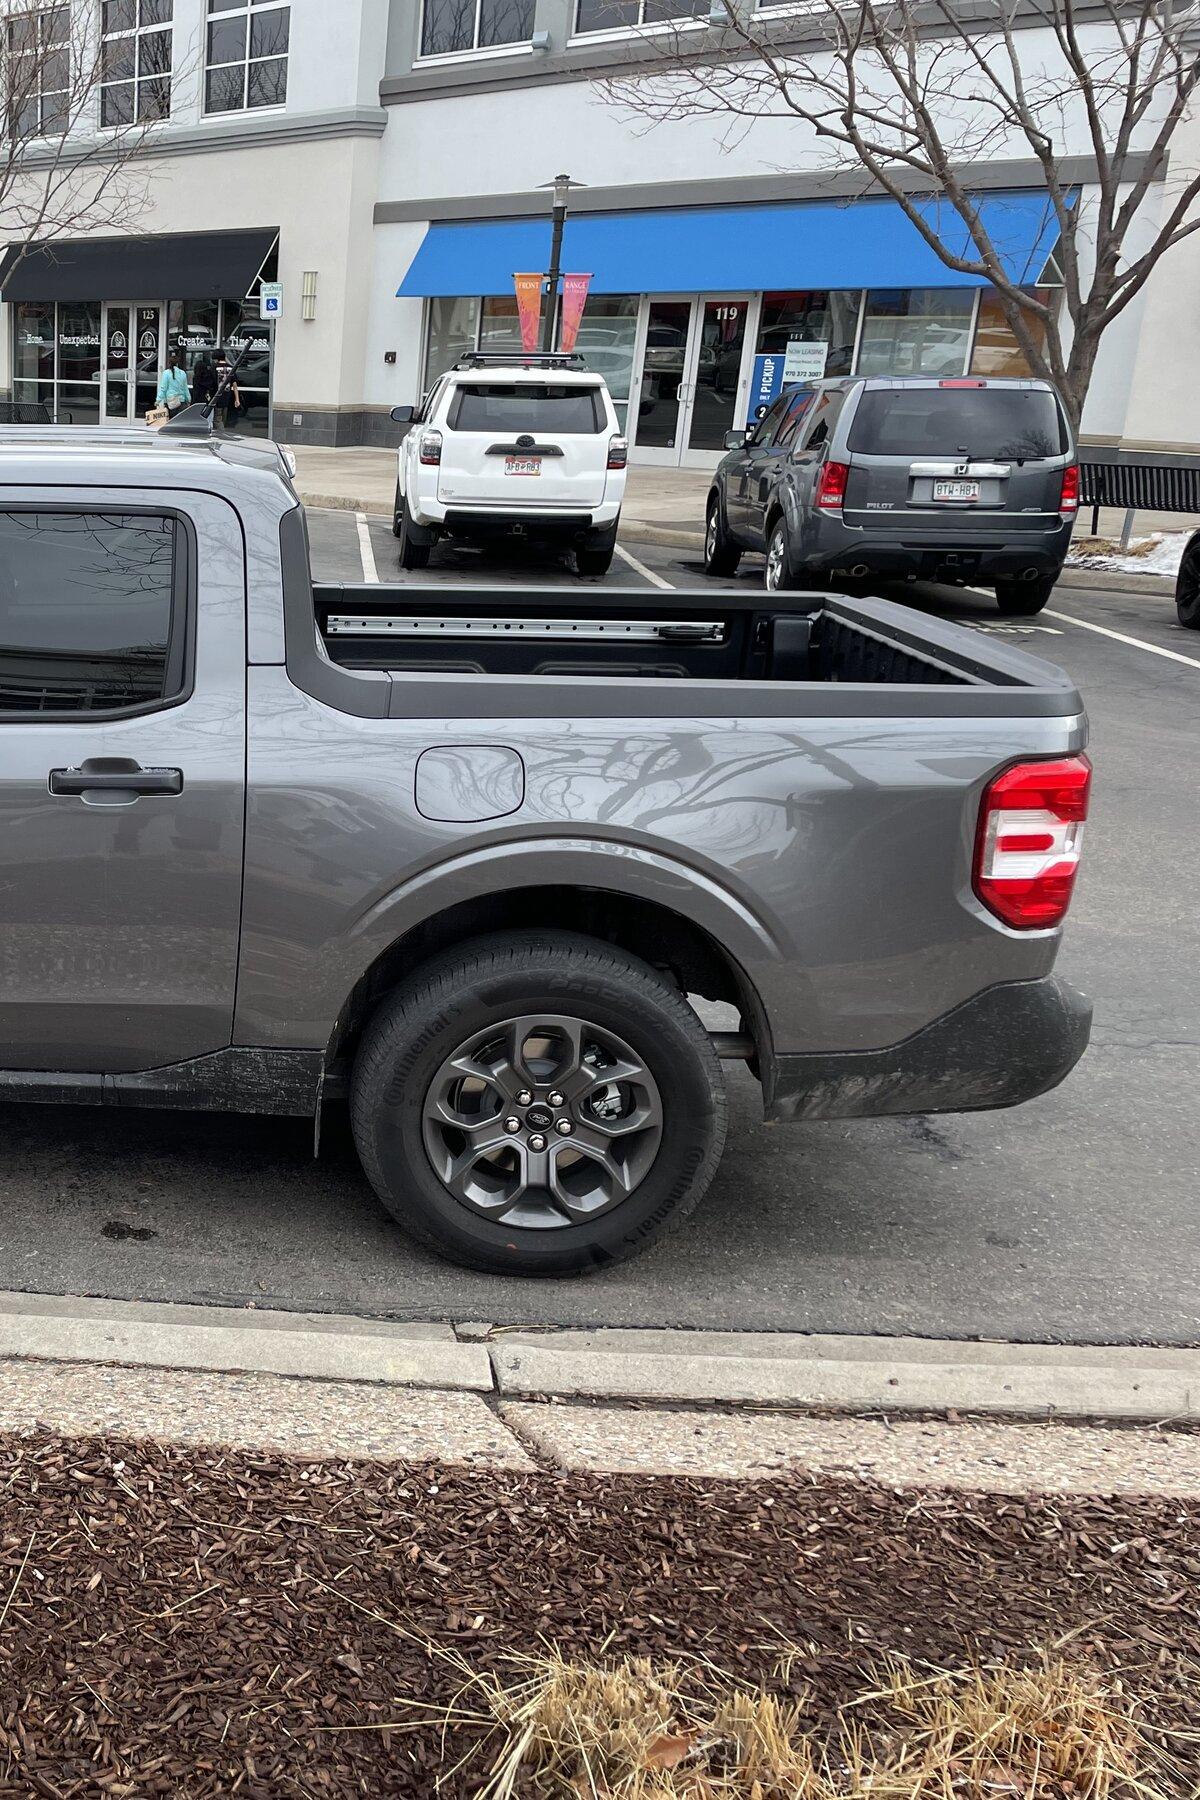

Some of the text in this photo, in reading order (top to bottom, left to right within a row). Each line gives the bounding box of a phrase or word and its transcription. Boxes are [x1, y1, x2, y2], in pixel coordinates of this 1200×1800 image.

[519, 281, 539, 289] FRONT
[565, 281, 586, 289] RANGE
[142, 310, 155, 320] 125
[716, 307, 738, 320] 119
[26, 333, 44, 344] Home.
[59, 333, 100, 347] Unexpected.
[177, 335, 206, 346] Create.
[760, 358, 775, 393] PICKUP
